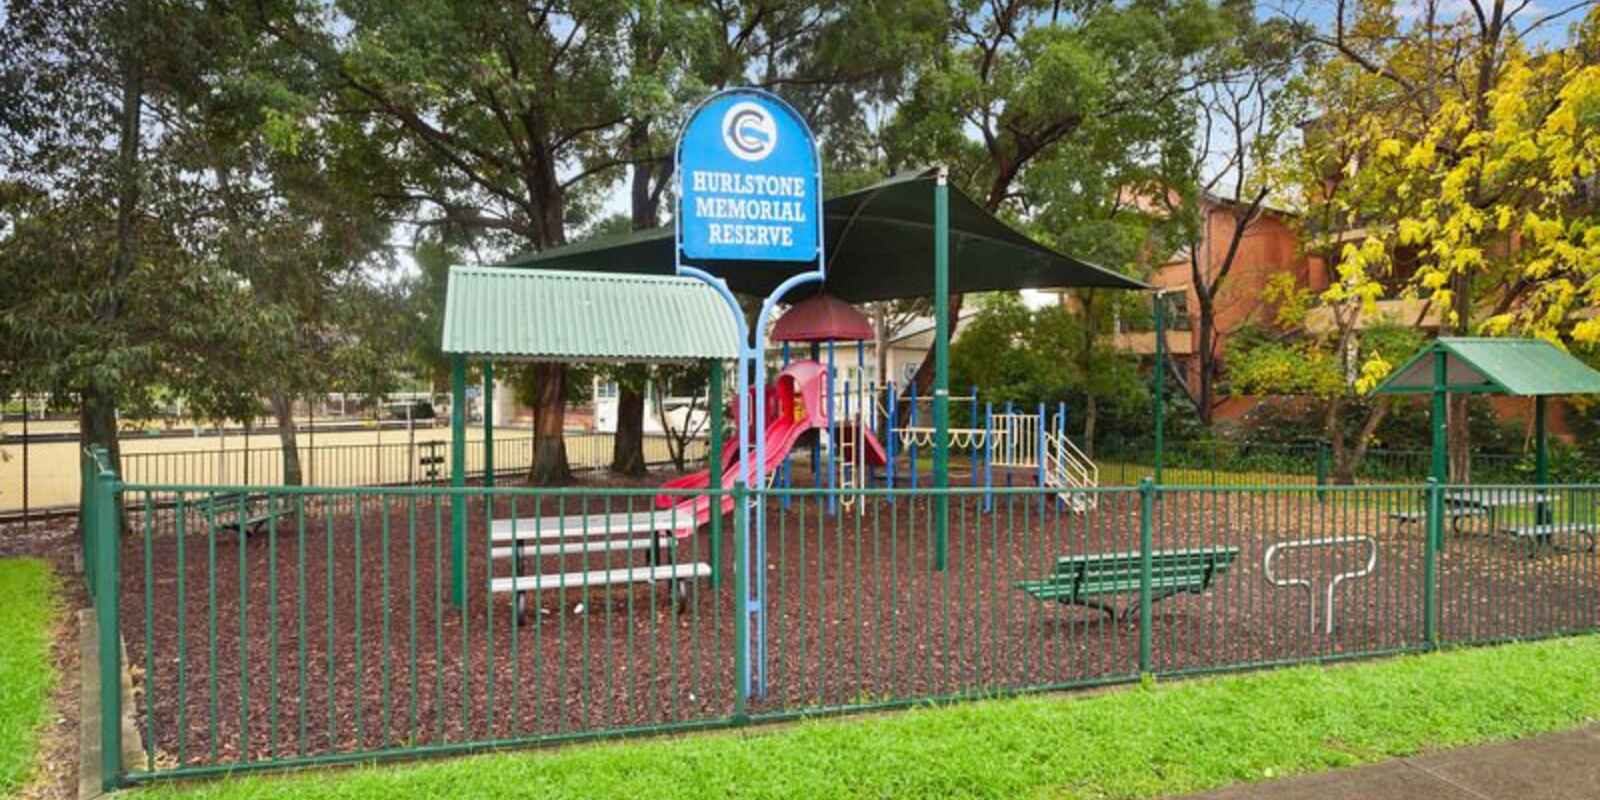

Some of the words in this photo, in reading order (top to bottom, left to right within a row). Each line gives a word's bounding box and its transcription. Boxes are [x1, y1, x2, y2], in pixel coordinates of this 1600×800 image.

[693, 170, 805, 197] HURLSTONE
[695, 197, 806, 222] MEMORIAL
[708, 222, 793, 246] RESERVE
